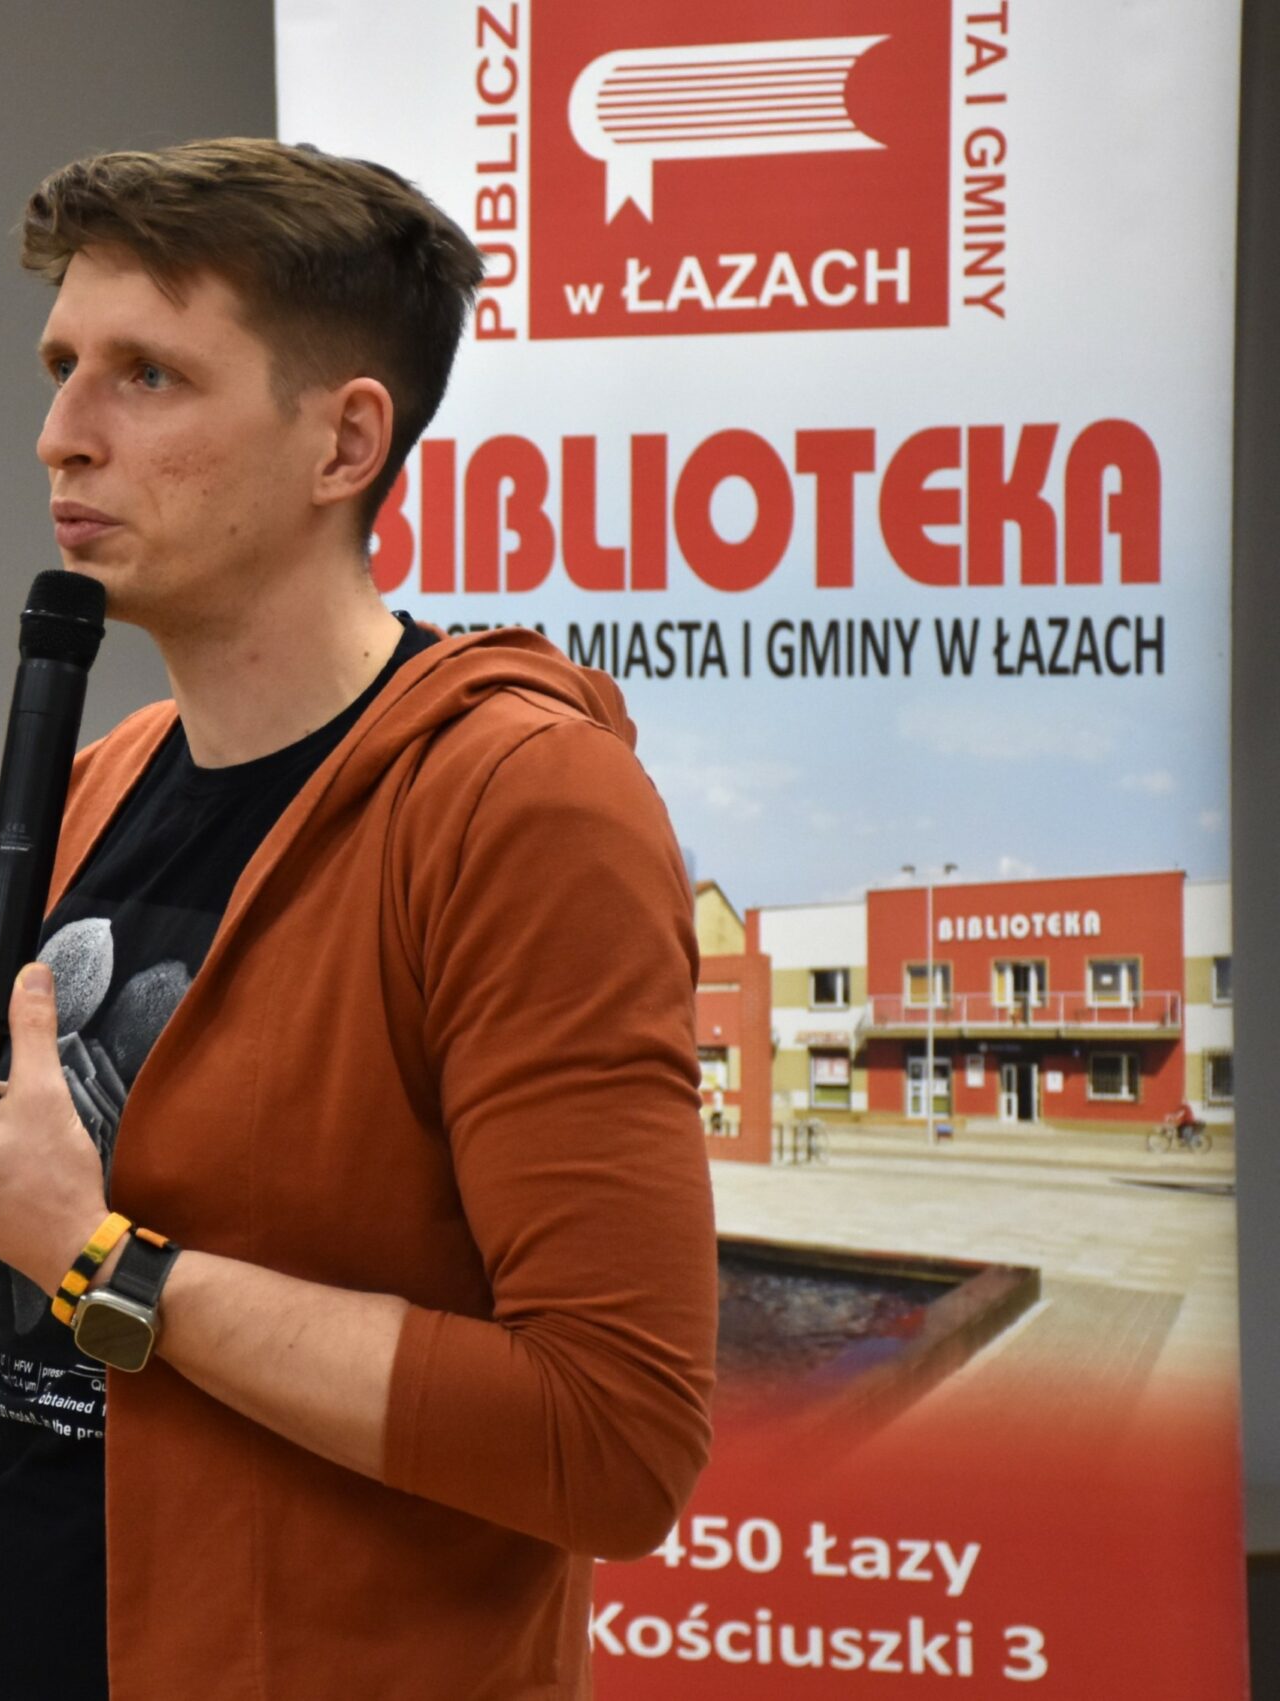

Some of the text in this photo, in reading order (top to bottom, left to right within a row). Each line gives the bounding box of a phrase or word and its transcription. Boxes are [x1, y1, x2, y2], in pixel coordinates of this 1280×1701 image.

[965, 93, 1008, 105] I
[963, 127, 1008, 319] GMINY
[622, 247, 911, 314] ŁAZACH
[567, 614, 1165, 680] MIASTA I GMINY W ŁAZACH
[937, 909, 1102, 943] BIBLIOTEKA
[38, 1391, 96, 1415] obtained
[51, 1419, 72, 1437] the
[640, 1514, 981, 1597] 450 Łazy
[587, 1601, 1049, 1682] Kościuszki 3
